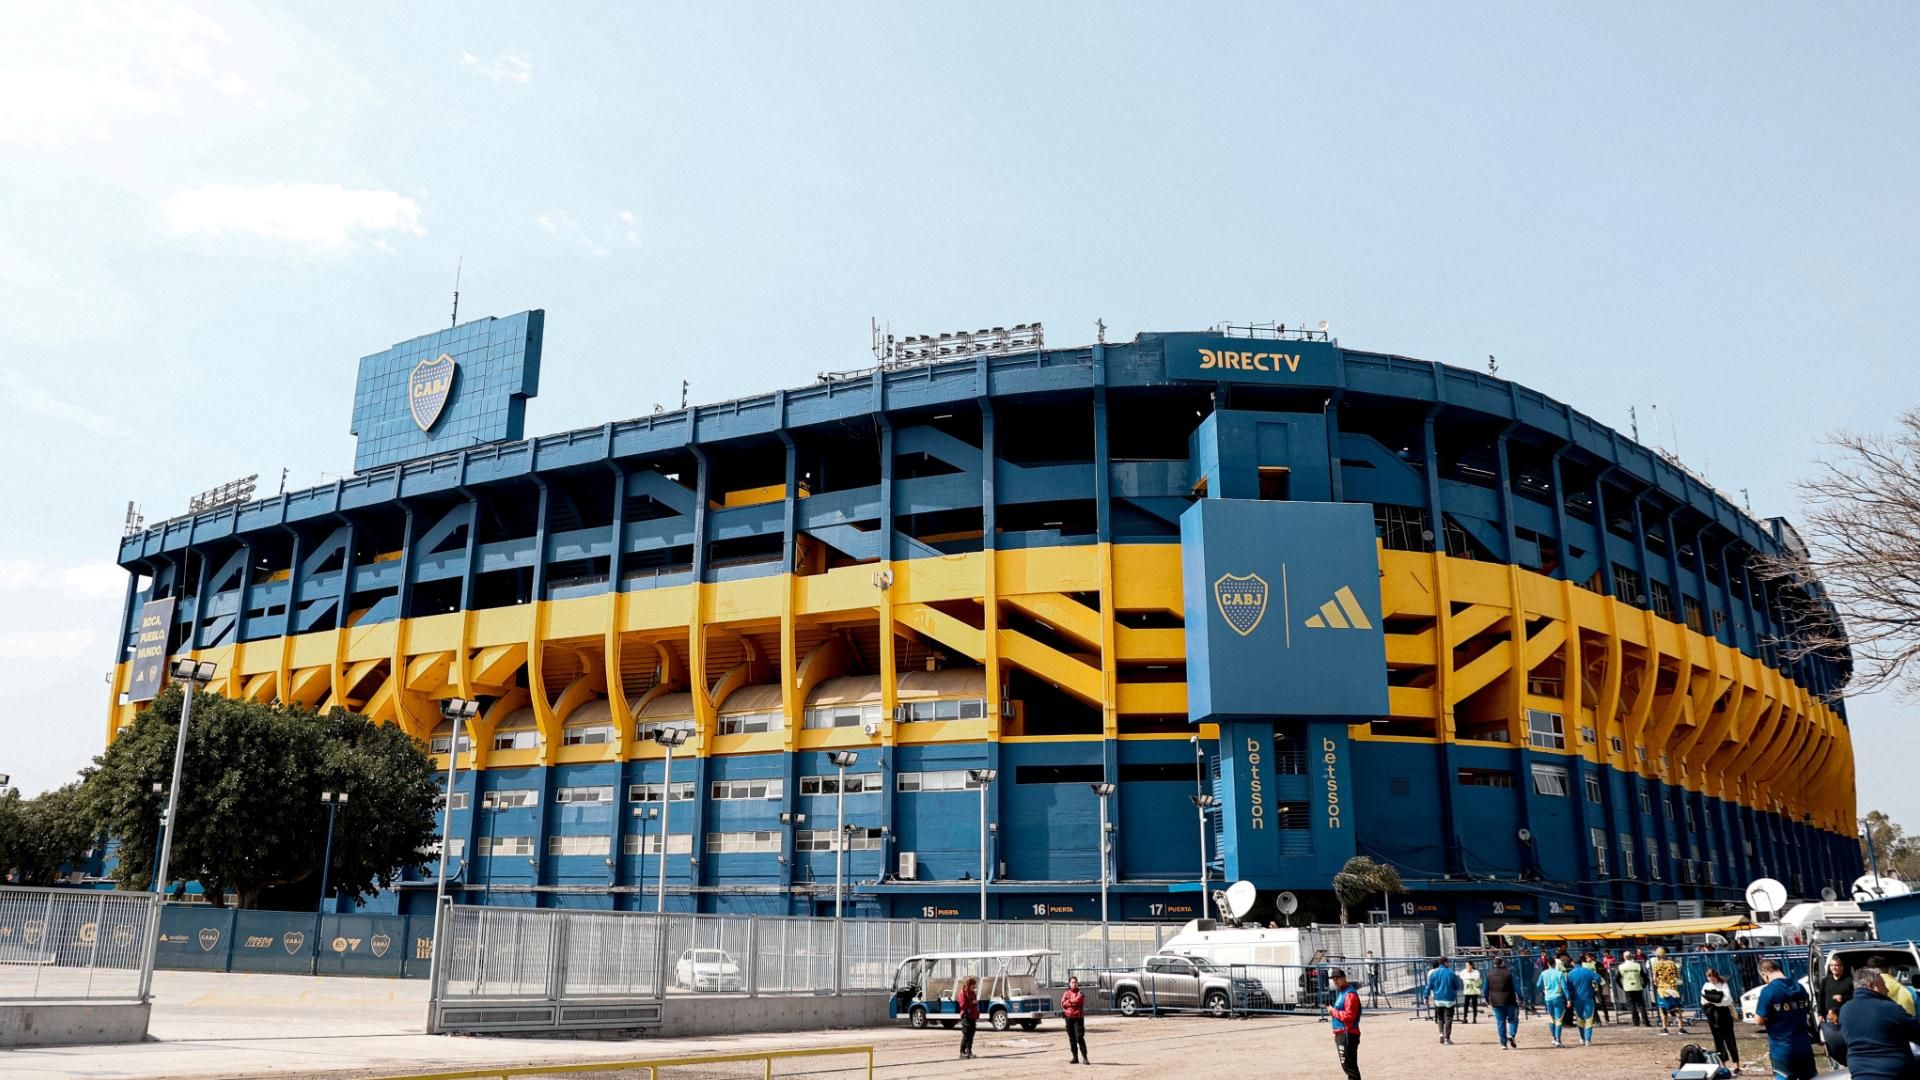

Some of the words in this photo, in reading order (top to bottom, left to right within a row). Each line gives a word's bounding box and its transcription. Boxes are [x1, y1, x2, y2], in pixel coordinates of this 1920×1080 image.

[1198, 348, 1300, 372] DIRECTV
[414, 376, 449, 398] CABJ
[1222, 593, 1262, 606] CABJ
[1247, 737, 1264, 829] betsson
[1323, 737, 1341, 829] betsson
[922, 906, 935, 918] 15
[1032, 903, 1046, 916] 16
[1149, 903, 1164, 916] 17
[1401, 902, 1415, 915] 19
[1493, 901, 1504, 914] 20
